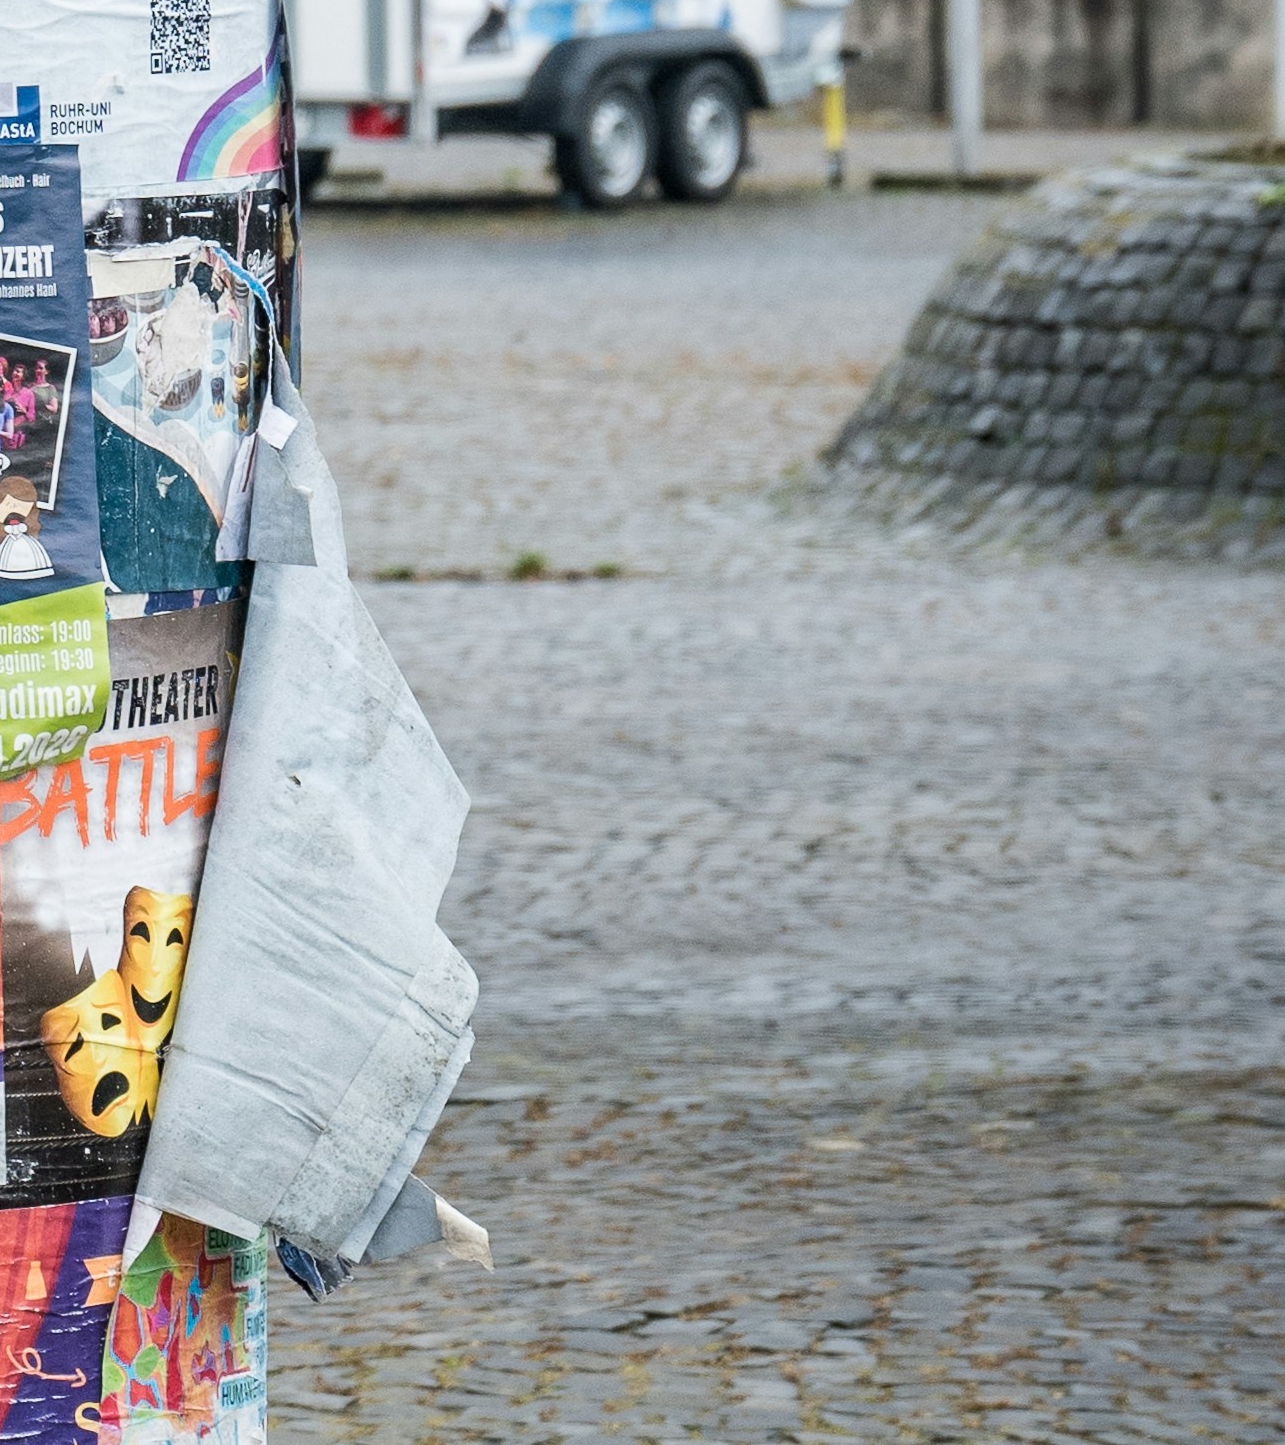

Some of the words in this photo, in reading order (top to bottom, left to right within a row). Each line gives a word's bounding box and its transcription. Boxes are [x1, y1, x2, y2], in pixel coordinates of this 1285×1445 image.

[50, 101, 111, 117] RUHR-UNI
[0, 122, 35, 139] AStA
[51, 119, 103, 134] BOCHUM
[32, 174, 50, 187] Hair
[50, 620, 91, 641] 19:00
[51, 648, 93, 670] 19:30
[113, 665, 219, 731] THEATER
